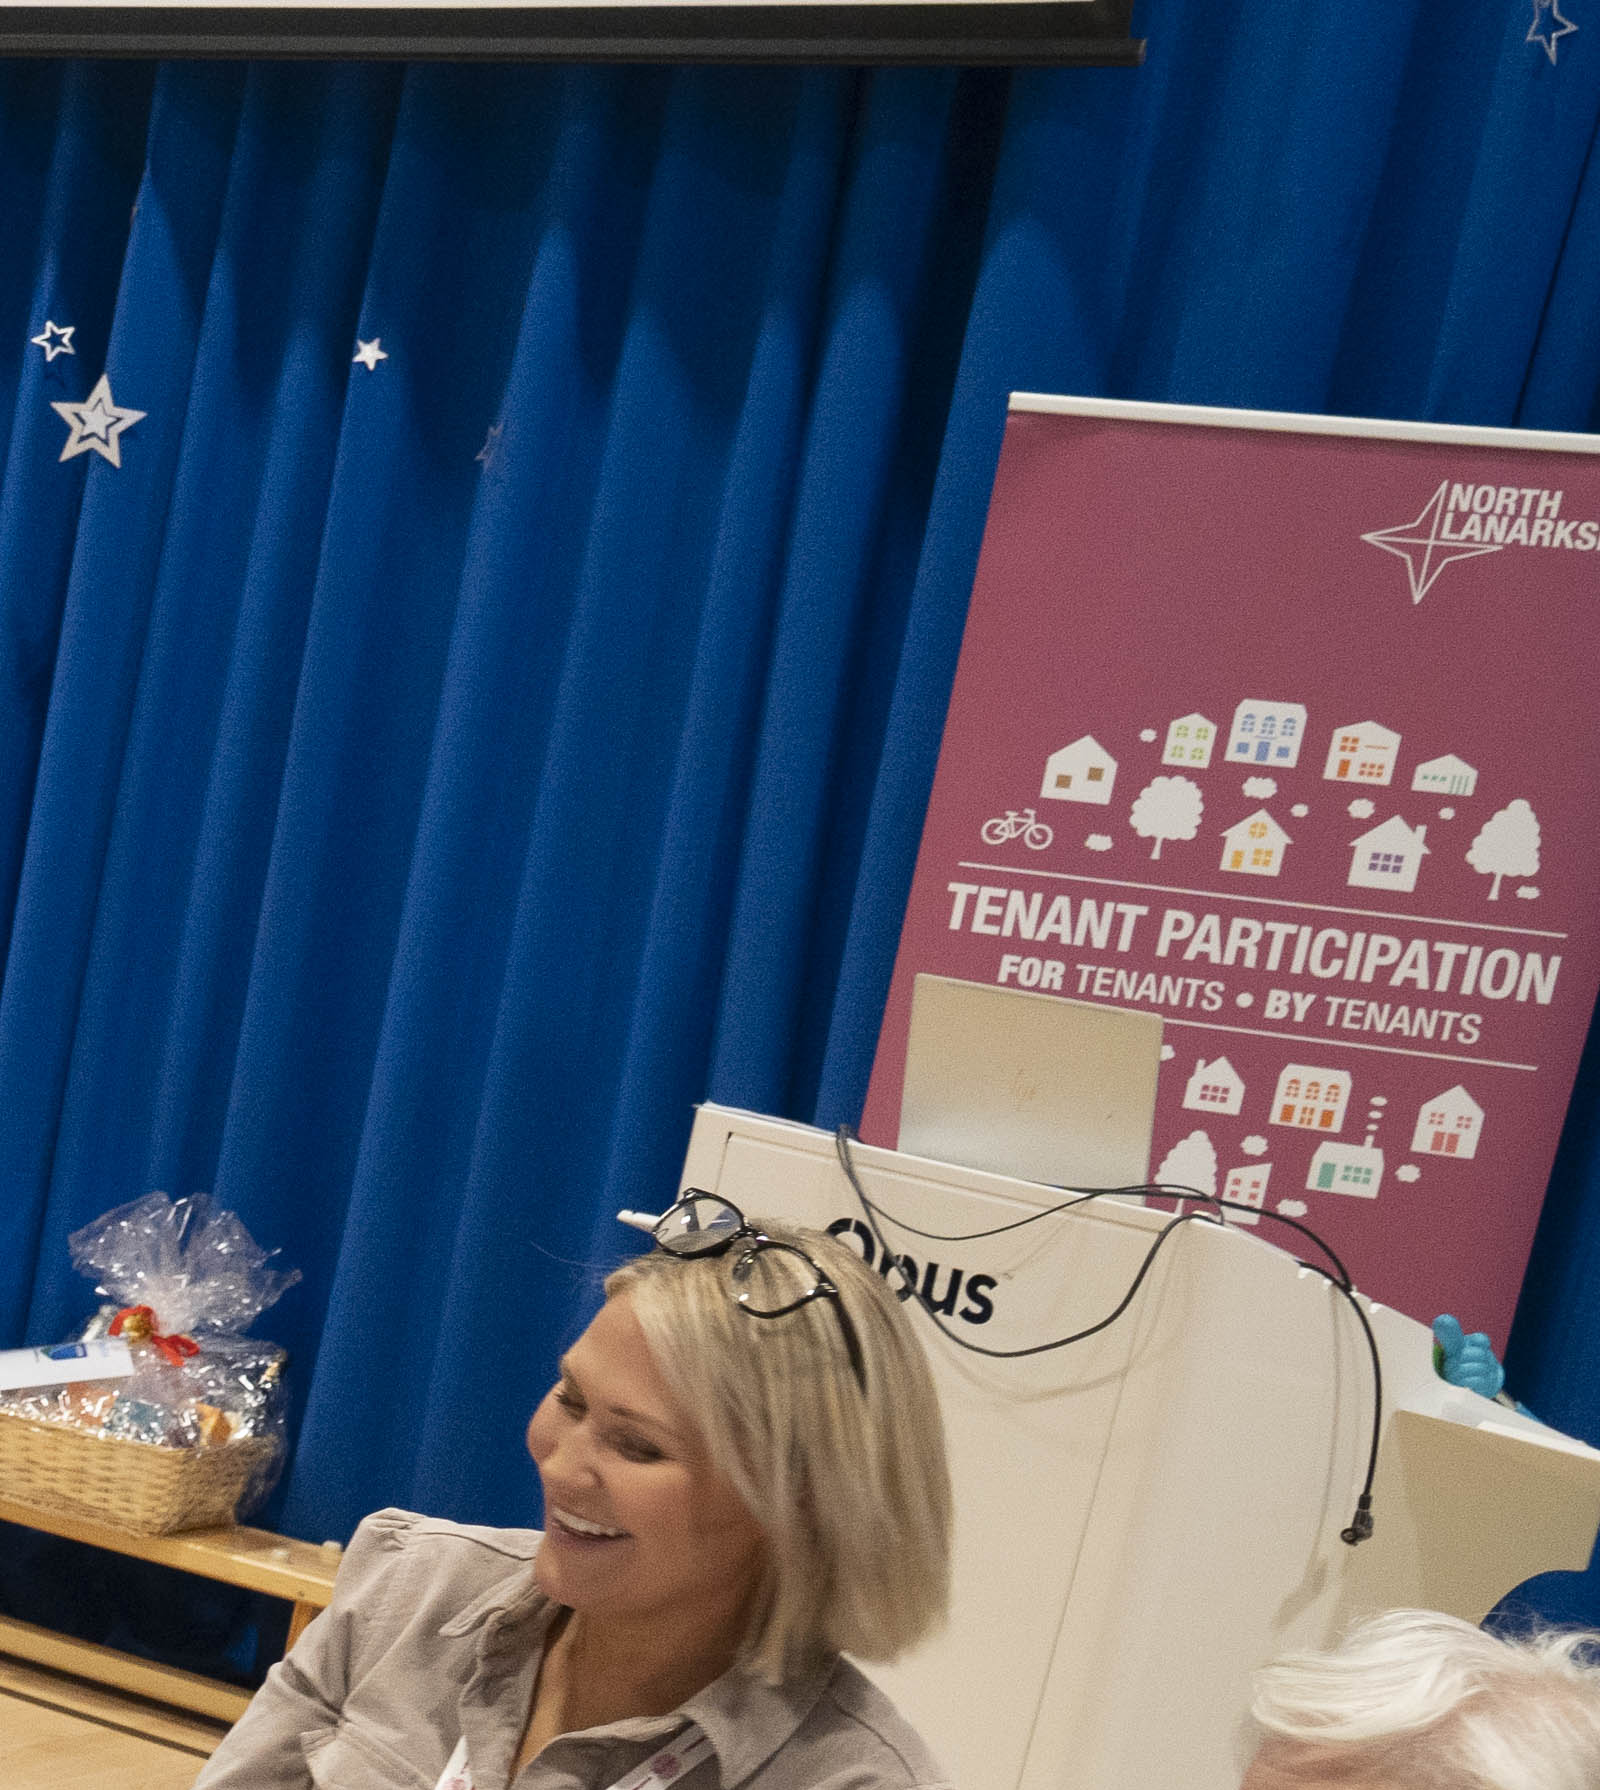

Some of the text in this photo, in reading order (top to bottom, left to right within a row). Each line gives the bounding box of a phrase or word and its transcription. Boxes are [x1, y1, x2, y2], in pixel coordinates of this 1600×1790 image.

[1440, 512, 1600, 552] LANARKS
[1447, 483, 1563, 518] NORTH
[948, 882, 1562, 1005] TENANT PARTICIPATION
[998, 954, 1483, 1045] FOR TENANTS BY TENANTS
